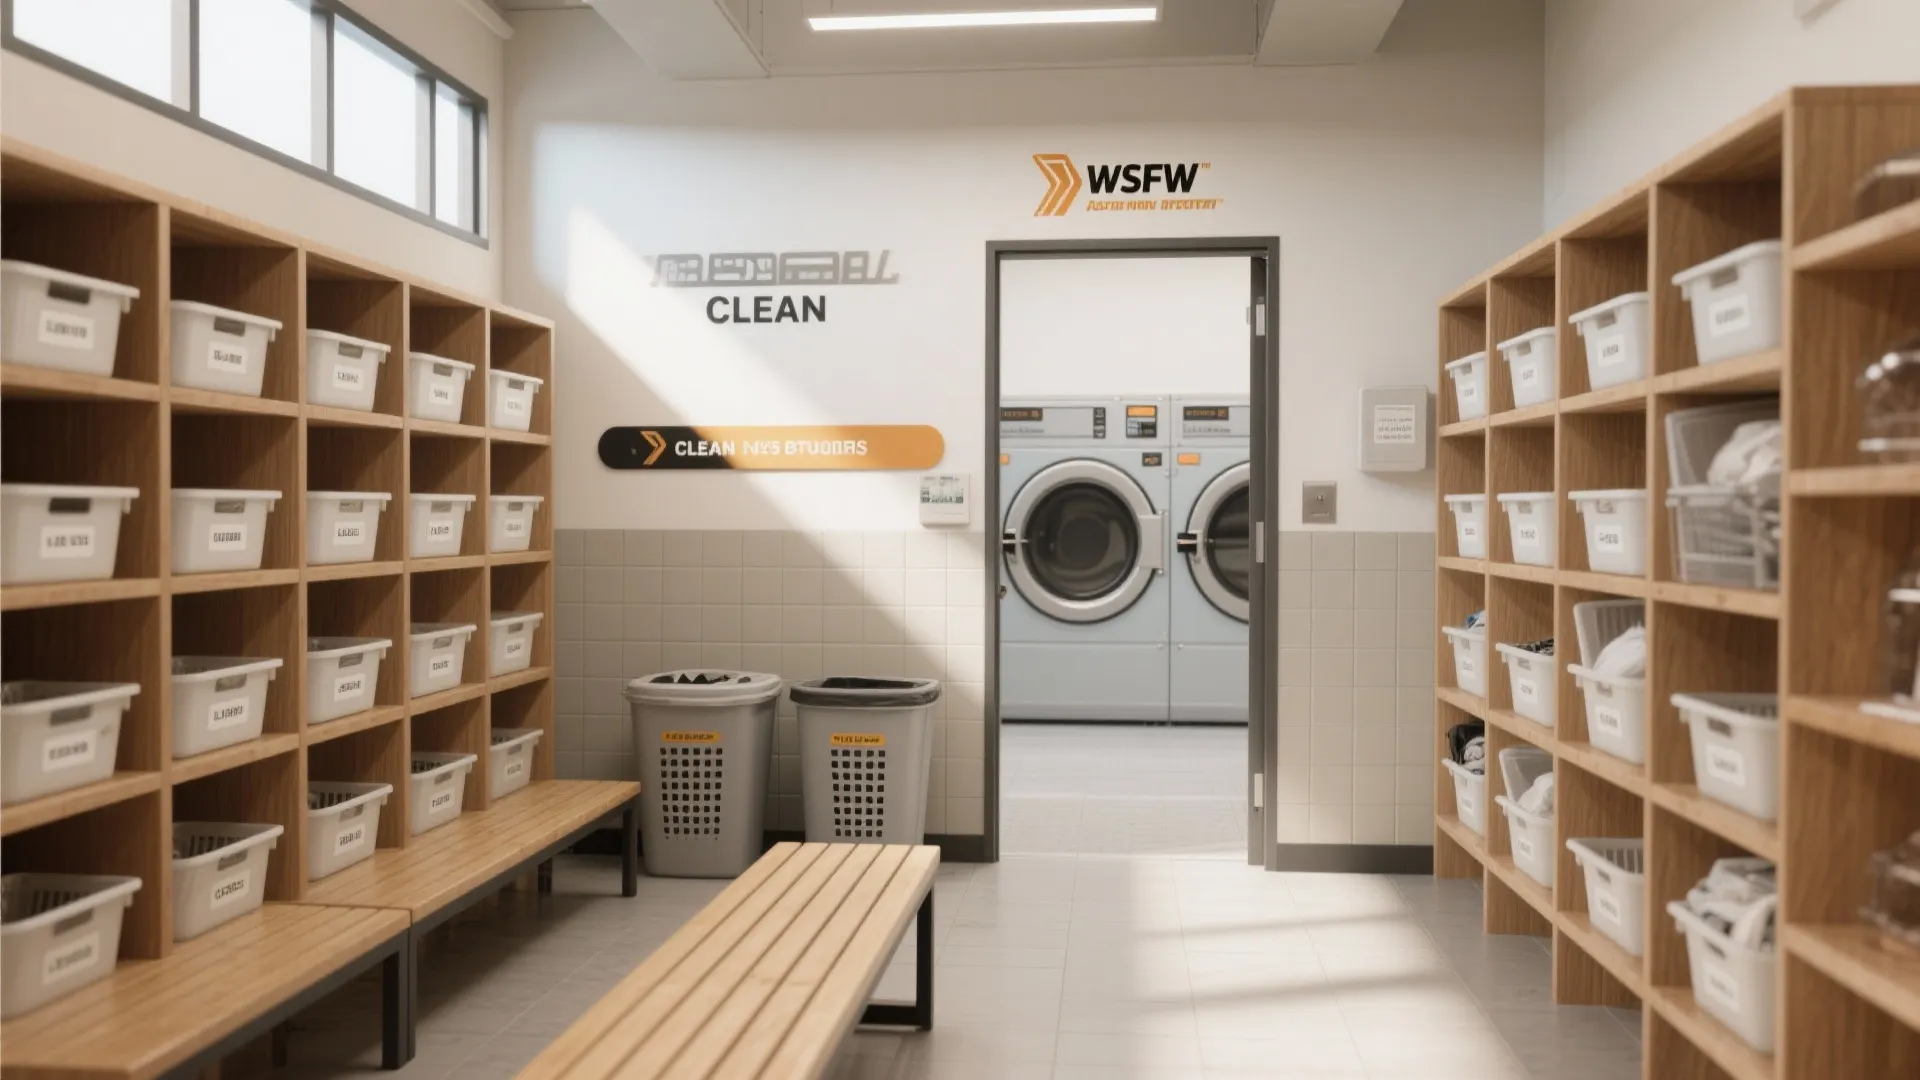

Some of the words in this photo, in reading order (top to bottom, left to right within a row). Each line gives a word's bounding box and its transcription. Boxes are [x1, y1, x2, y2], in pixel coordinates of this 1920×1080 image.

[1087, 163, 1199, 194] WSFW
[706, 295, 826, 324] CLEAN
[674, 440, 735, 457] CLEAN
